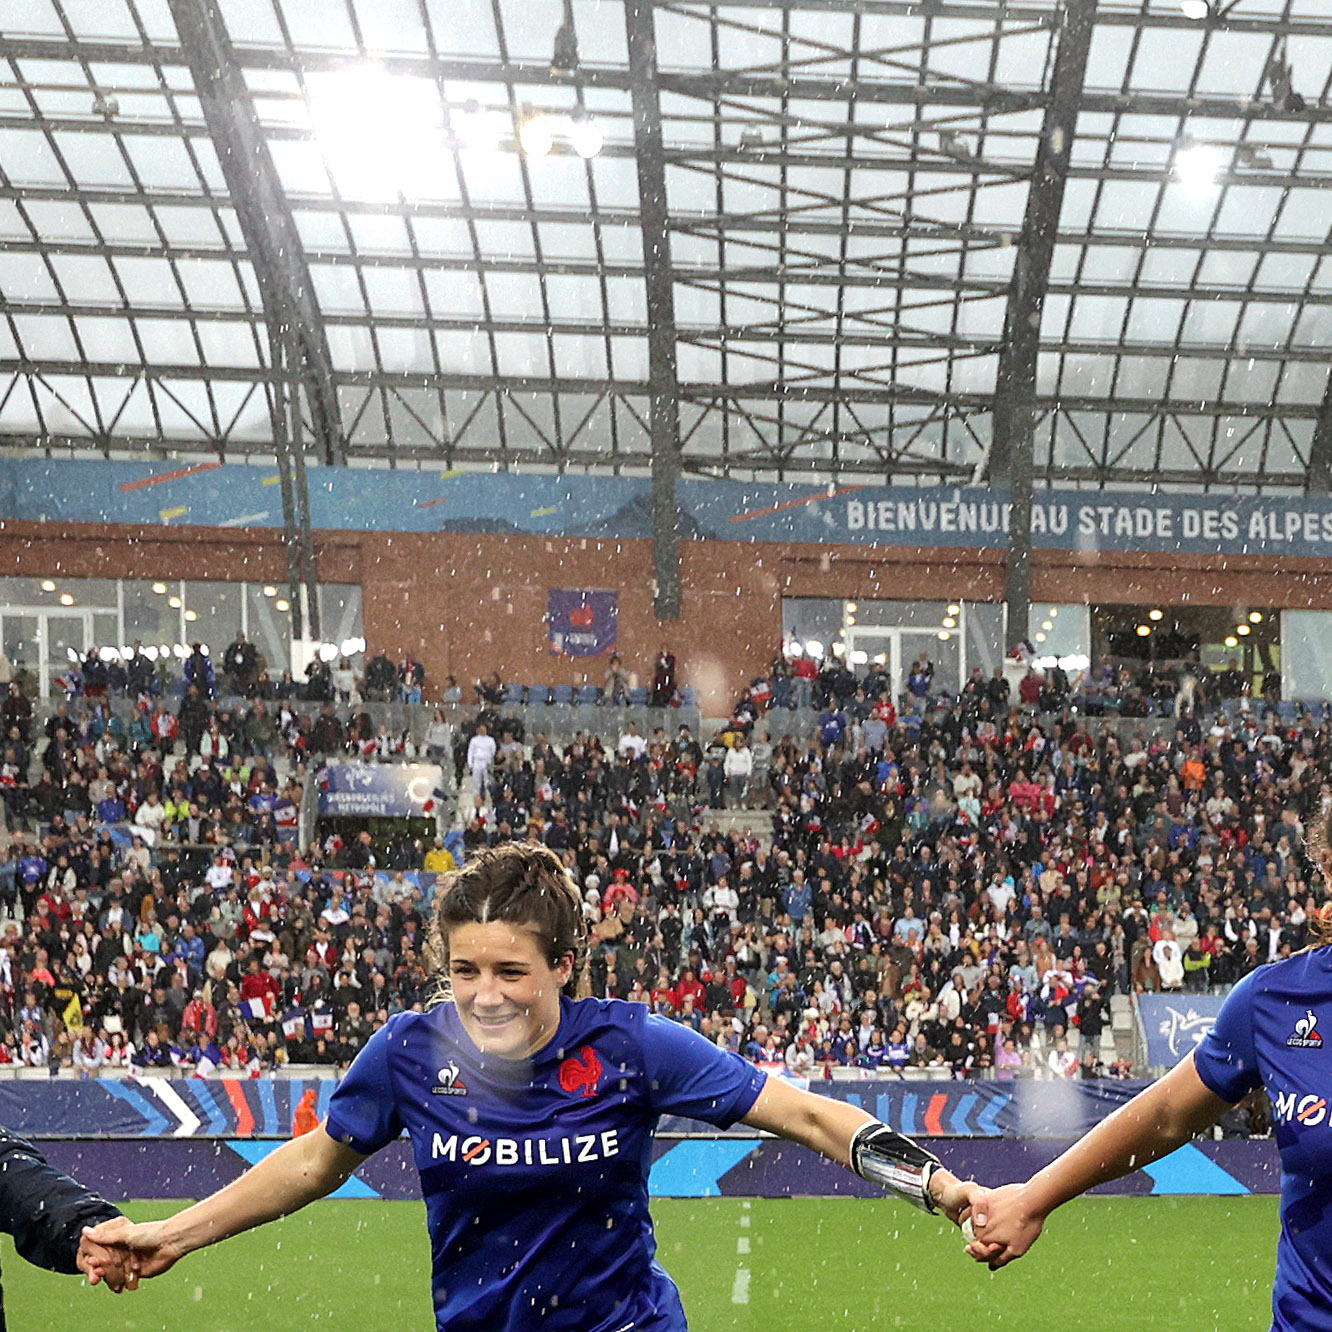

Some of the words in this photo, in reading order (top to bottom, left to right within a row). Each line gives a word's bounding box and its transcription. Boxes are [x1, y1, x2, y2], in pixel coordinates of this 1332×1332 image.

[1031, 504, 1069, 533] AU
[1078, 505, 1173, 538] STADE
[1183, 508, 1239, 540] DES
[431, 1129, 619, 1166] MOBILIZE
